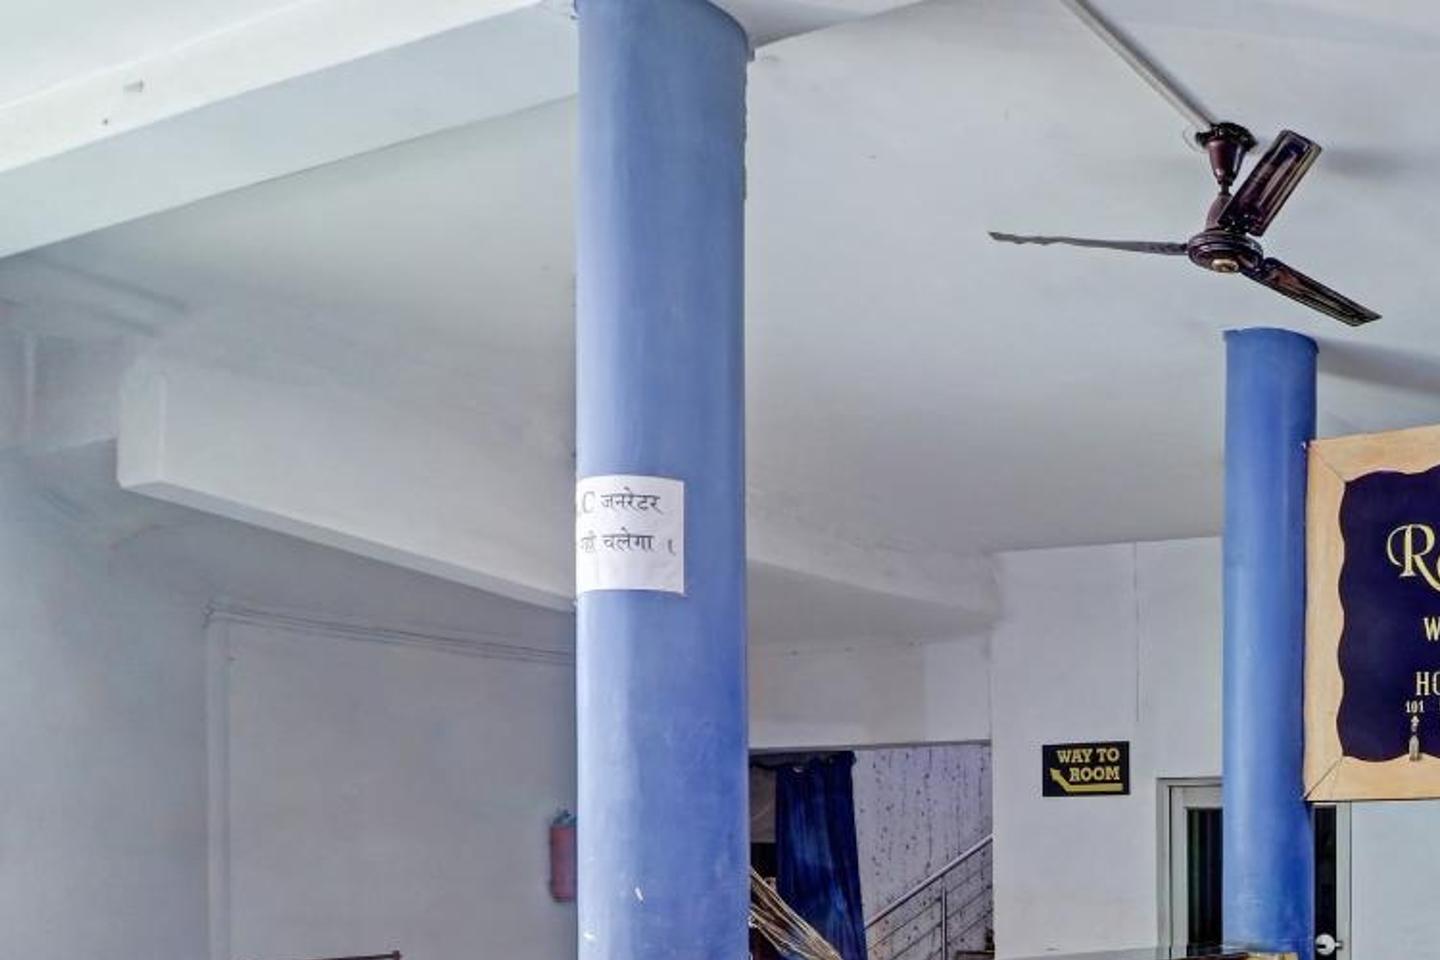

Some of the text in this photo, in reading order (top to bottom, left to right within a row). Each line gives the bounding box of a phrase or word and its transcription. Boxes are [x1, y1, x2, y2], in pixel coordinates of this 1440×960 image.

[1405, 700, 1425, 714] 101
[1056, 747, 1120, 764] WAY TO
[1068, 765, 1120, 782] ROOM
